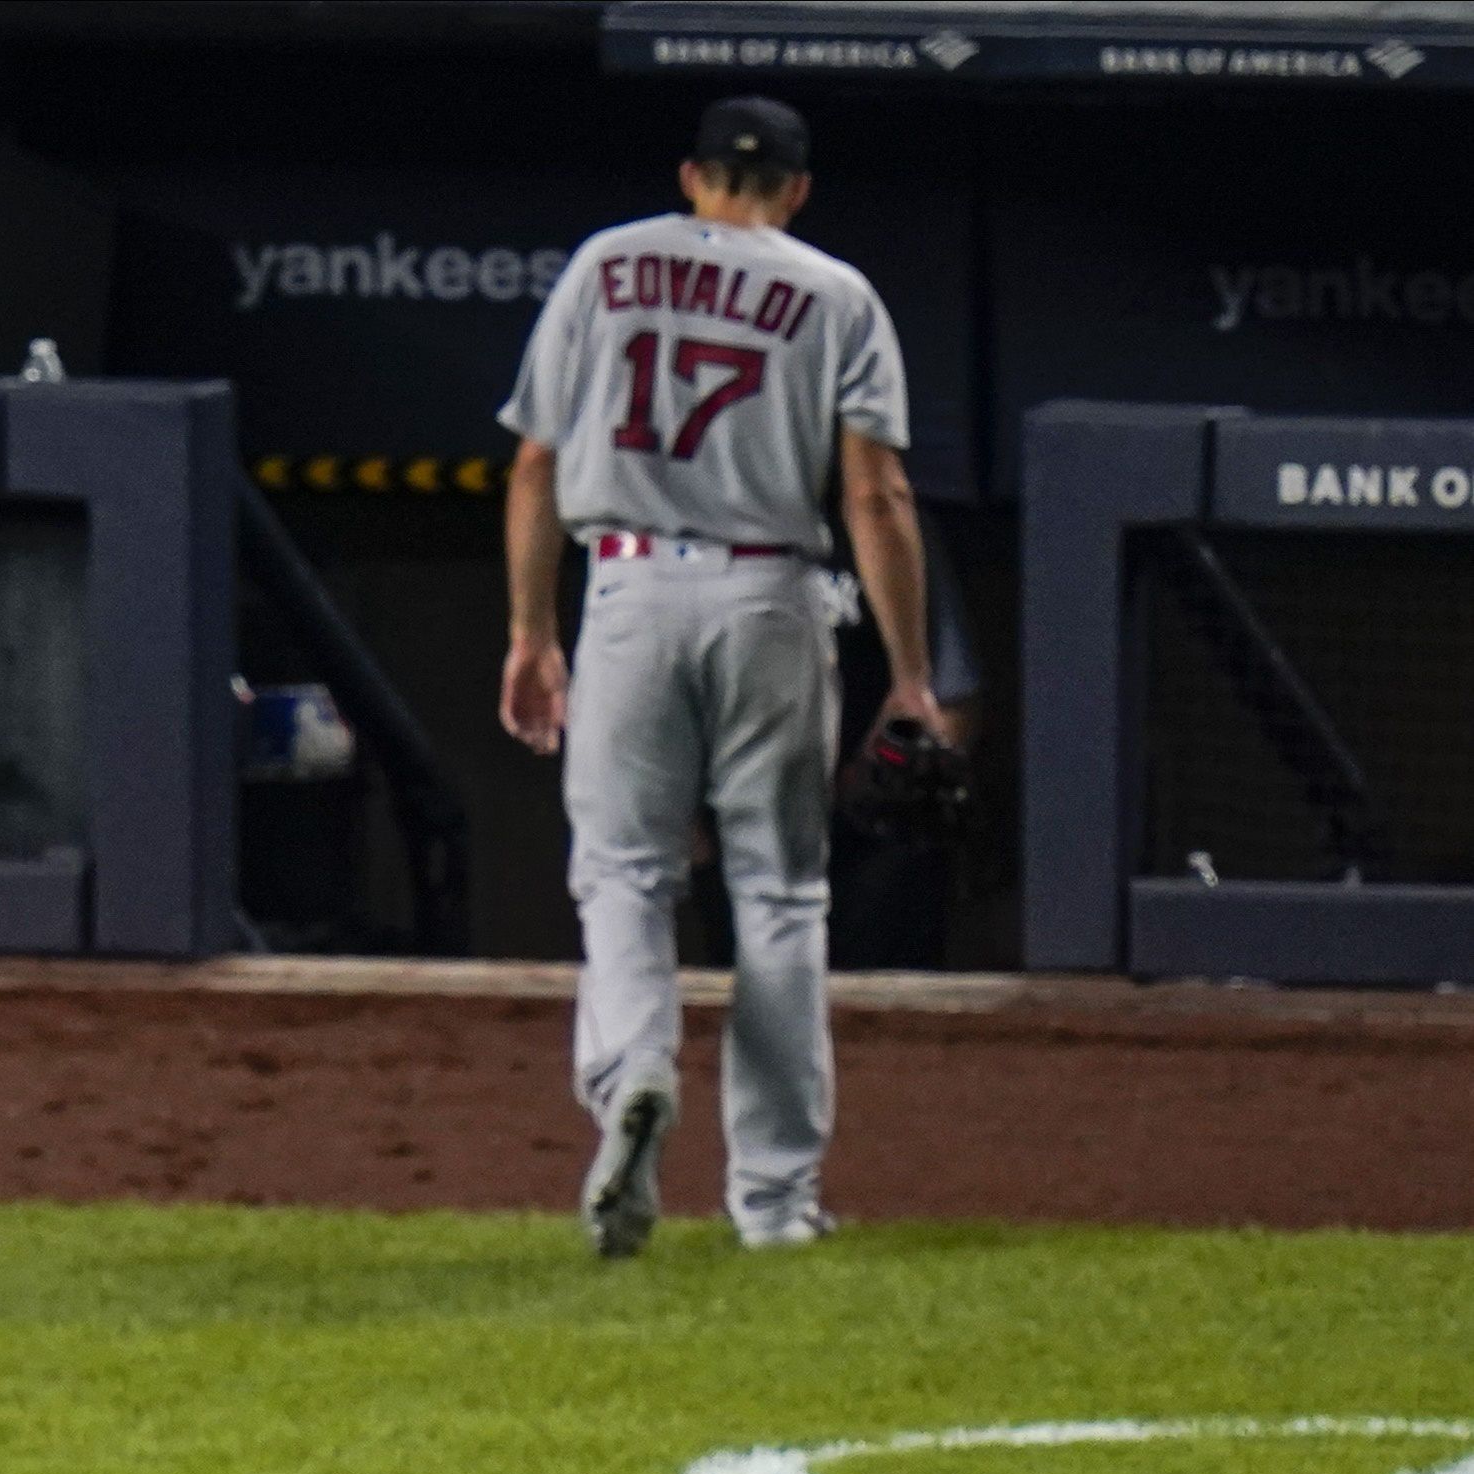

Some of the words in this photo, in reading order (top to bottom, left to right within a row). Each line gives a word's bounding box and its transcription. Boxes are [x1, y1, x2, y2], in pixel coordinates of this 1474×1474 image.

[654, 36, 734, 64] BANK
[739, 37, 779, 66] OF
[782, 39, 917, 68] AMERICA
[1099, 45, 1183, 74] BANK
[1185, 47, 1225, 75] OF
[1228, 49, 1362, 76] AMERICA
[227, 232, 566, 309] yankees
[600, 253, 815, 342] EOVALDI
[614, 330, 767, 462] 17
[1276, 462, 1420, 507] BANK
[1429, 465, 1474, 509] O
